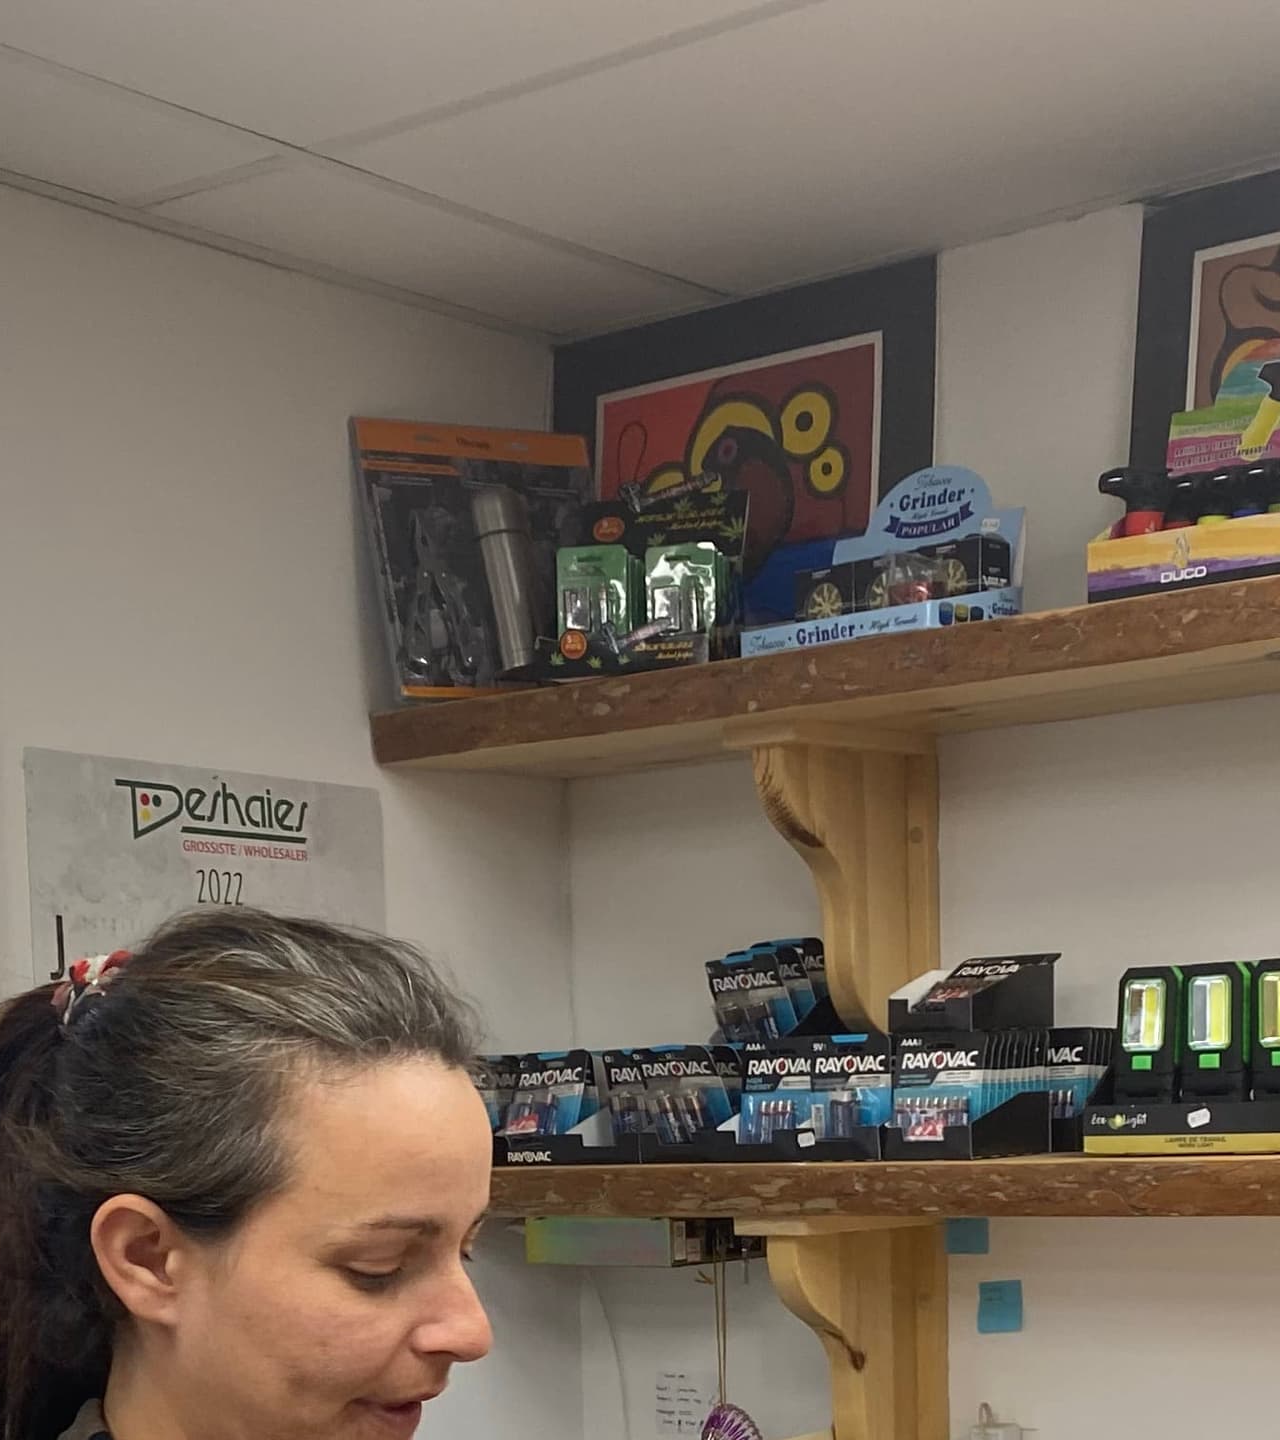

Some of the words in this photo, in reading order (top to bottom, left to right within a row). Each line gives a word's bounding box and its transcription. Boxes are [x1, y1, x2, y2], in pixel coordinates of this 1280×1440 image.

[899, 487, 966, 512] Grinder
[901, 518, 957, 537] POPULAR
[1160, 565, 1207, 584] DUCO
[796, 623, 856, 645] Grinder
[114, 778, 309, 840] Deshaies
[183, 839, 237, 857] GROSSISTE
[244, 844, 308, 861] WHOLESALER
[196, 868, 243, 906] 2022
[713, 971, 777, 993] RAYOVAC
[815, 1055, 886, 1074] RAYOVAC
[901, 1050, 979, 1069] RAYOVAC
[1048, 1046, 1084, 1064] VAC
[519, 1066, 583, 1088] RAYOVAC
[642, 1061, 712, 1077] RAYOVAC
[507, 1150, 552, 1162] RAYOVAC
